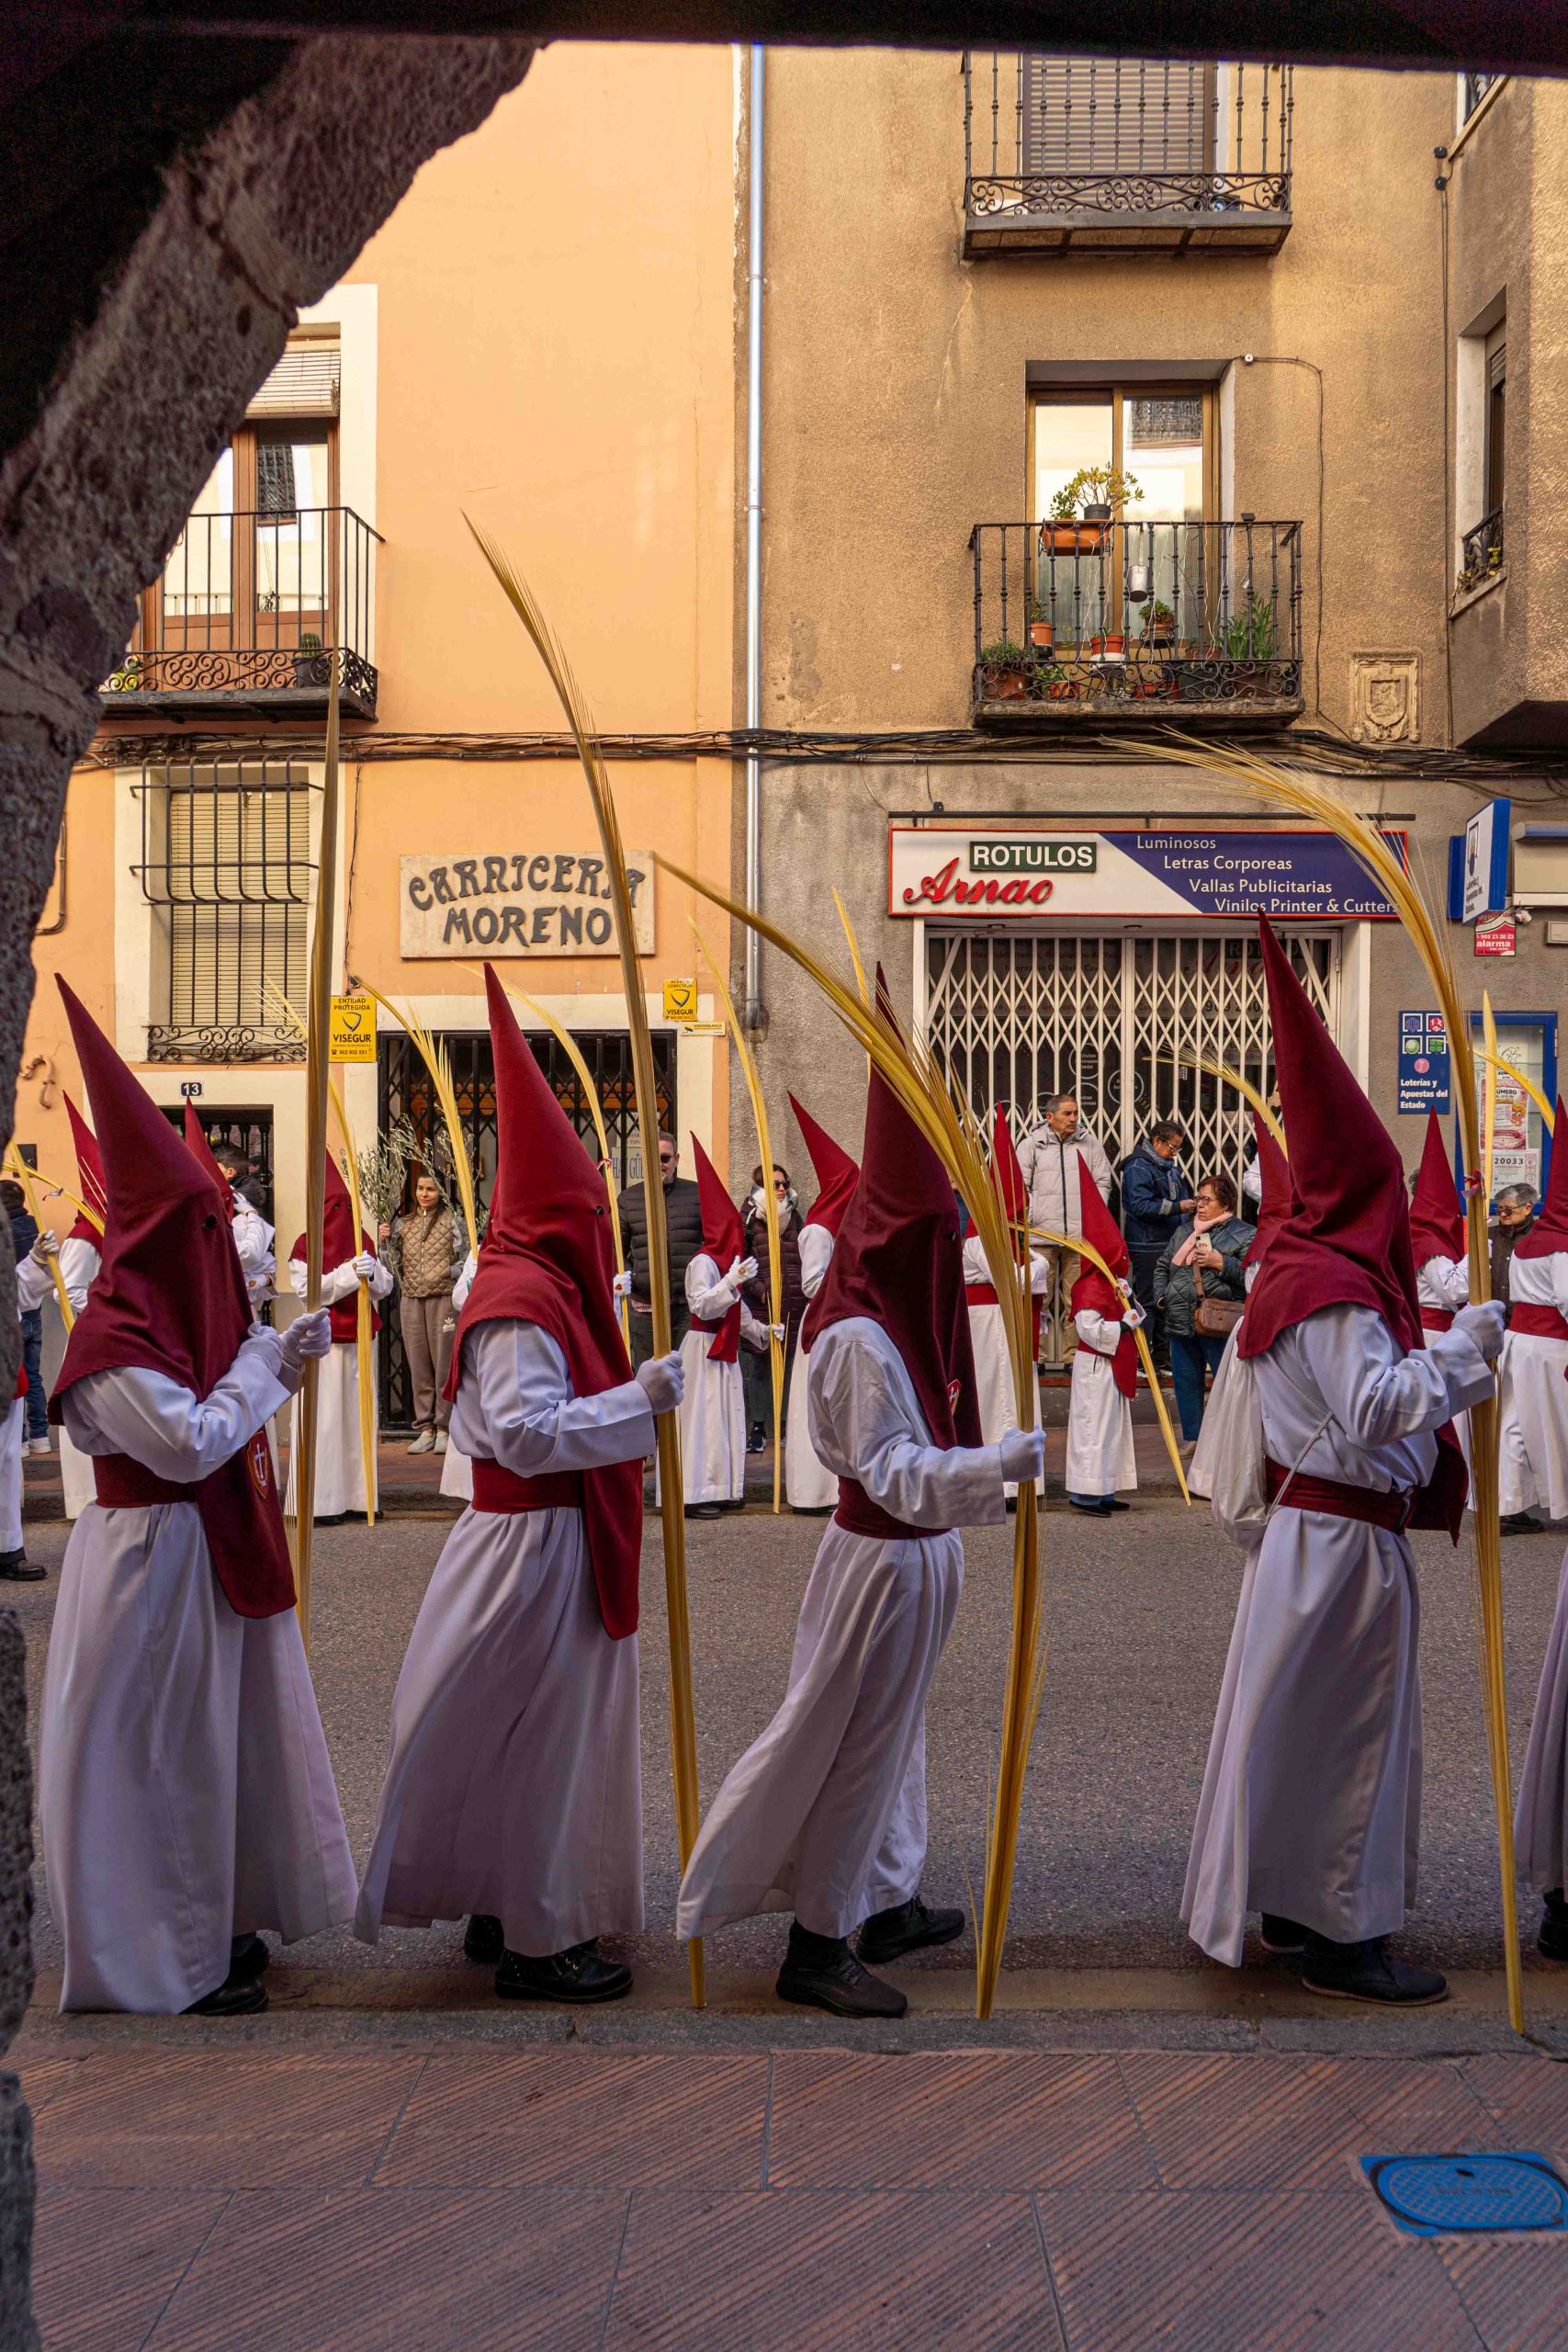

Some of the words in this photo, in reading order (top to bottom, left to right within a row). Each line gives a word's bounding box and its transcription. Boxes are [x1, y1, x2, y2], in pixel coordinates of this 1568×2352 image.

[1136, 835, 1216, 849] Luminosos
[973, 845, 1093, 867] ROTULOS
[1164, 855, 1210, 869] Letras
[1213, 855, 1292, 873] Corporeas
[903, 857, 1054, 905] Arnao
[1190, 878, 1235, 893] Vallas
[1239, 878, 1332, 893] Publicitarias
[1215, 898, 1267, 912] Vinilos
[1270, 899, 1322, 912] Printer
[1326, 899, 1339, 912] &
[443, 905, 613, 947] MORENO
[1476, 939, 1511, 947] alarma
[333, 1035, 371, 1043] VISEGUR
[184, 1083, 199, 1095] 13
[1432, 1080, 1438, 1088] y
[1400, 1090, 1435, 1099] Apuestas
[1436, 1090, 1449, 1098] del
[1400, 1101, 1426, 1109] Estado
